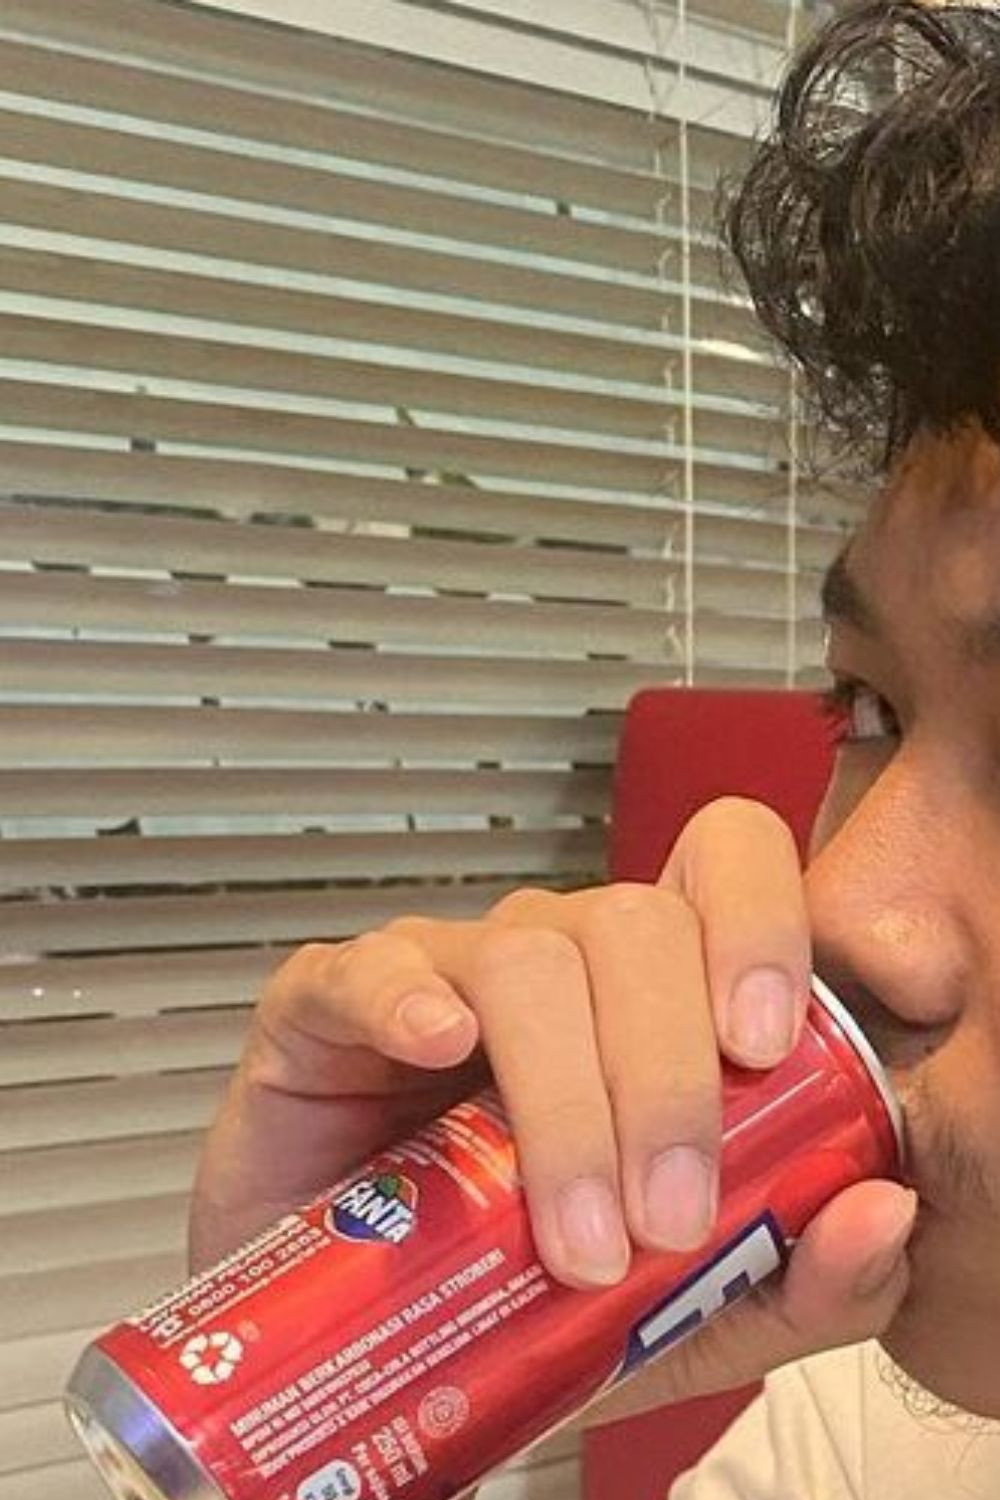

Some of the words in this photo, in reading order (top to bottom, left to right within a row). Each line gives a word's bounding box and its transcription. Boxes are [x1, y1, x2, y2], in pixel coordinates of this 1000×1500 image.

[334, 1180, 414, 1243] FANTA
[227, 1382, 302, 1439] MINUMAN
[295, 1313, 406, 1393] BERKARBONASI
[398, 1287, 444, 1325] RASA
[435, 1245, 507, 1300] STROBERI
[368, 1423, 405, 1465] 250
